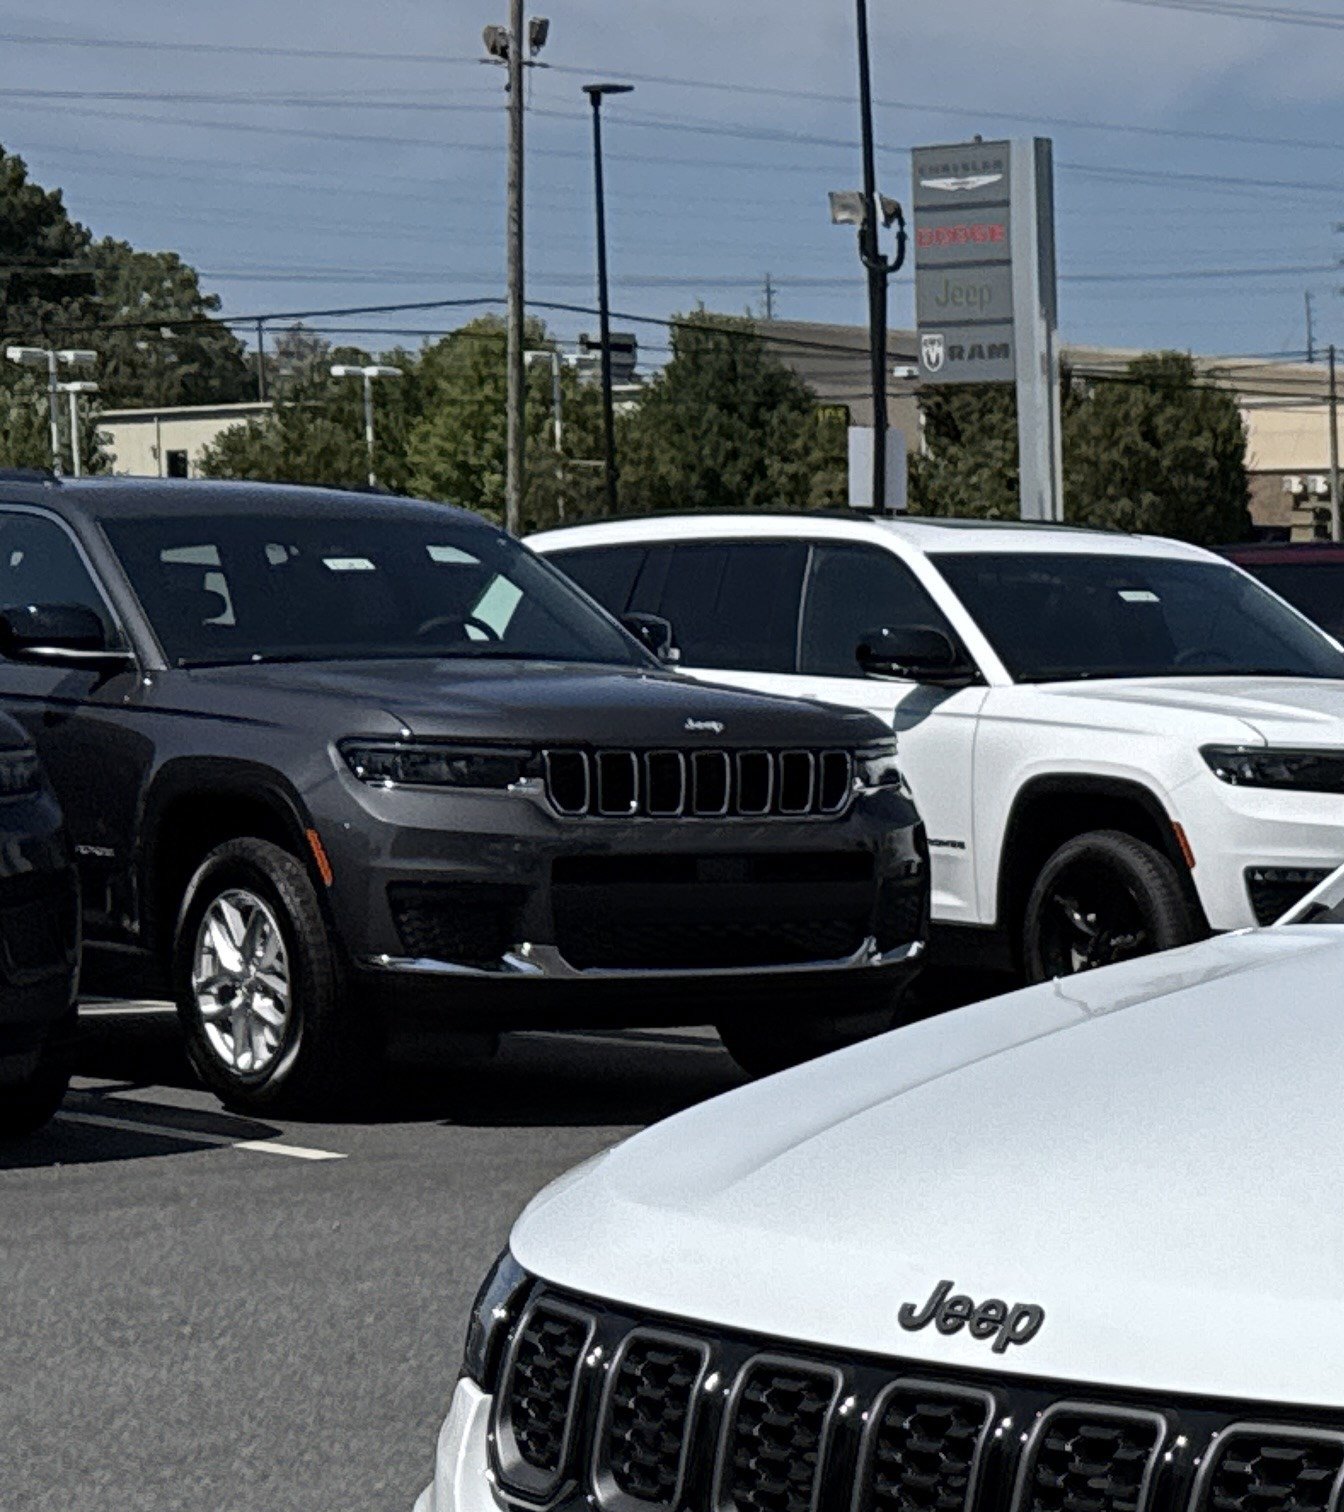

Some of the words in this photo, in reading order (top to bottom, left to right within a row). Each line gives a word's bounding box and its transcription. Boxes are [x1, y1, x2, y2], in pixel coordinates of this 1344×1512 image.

[935, 279, 991, 312] Jeep
[949, 343, 1010, 361] RAM
[897, 1279, 1045, 1354] Jeep
